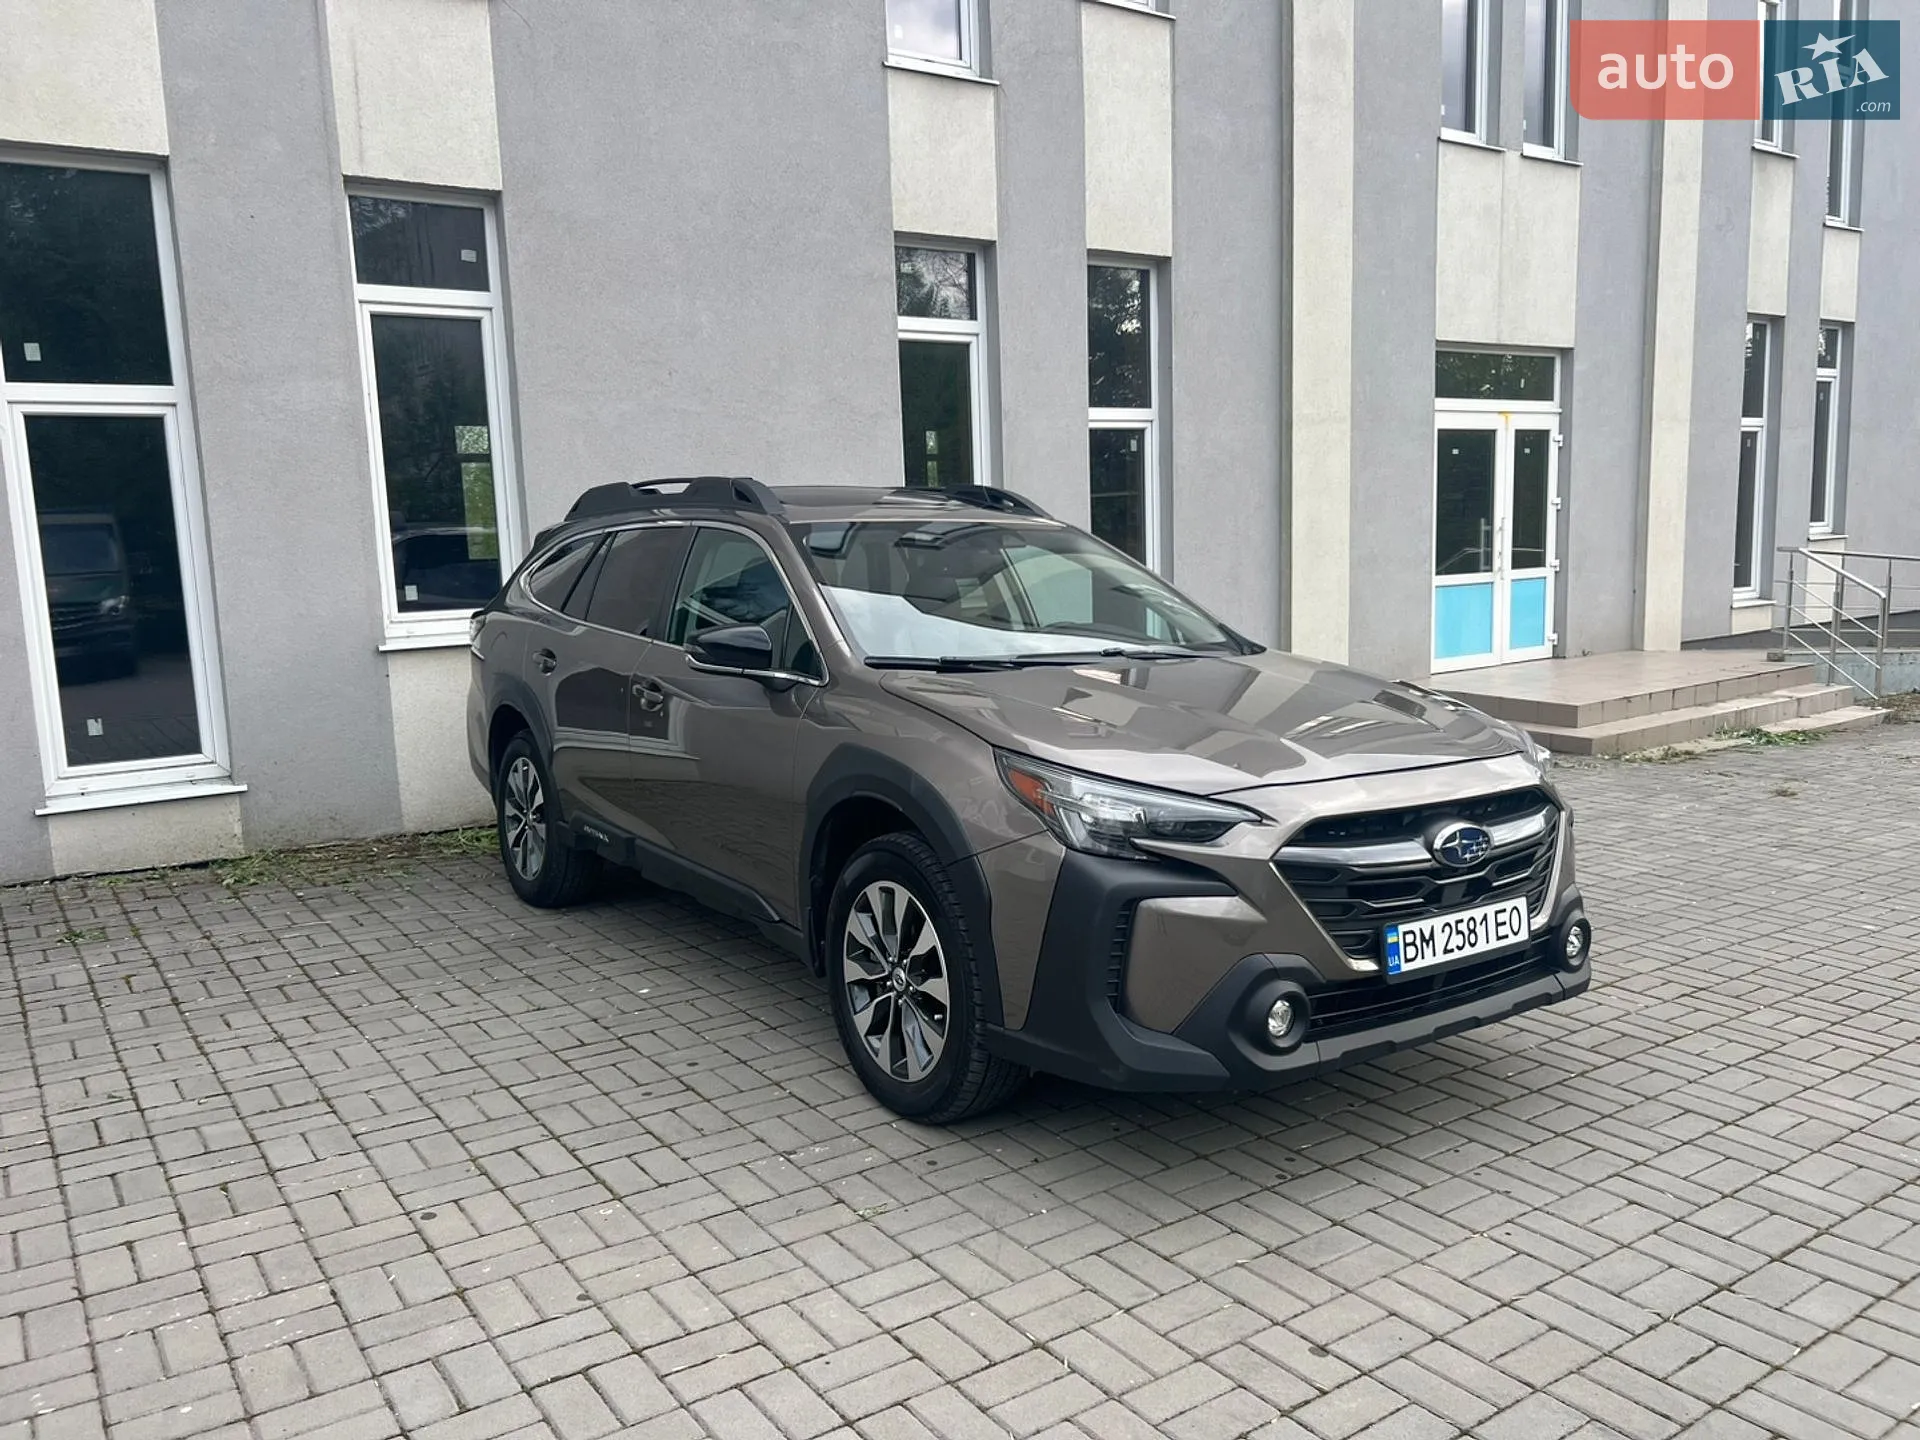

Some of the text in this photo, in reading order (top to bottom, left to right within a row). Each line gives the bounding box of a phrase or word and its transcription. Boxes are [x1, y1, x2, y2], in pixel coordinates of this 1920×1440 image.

[1402, 905, 1522, 964] BM 2581 EO
[1388, 955, 1400, 967] UA
